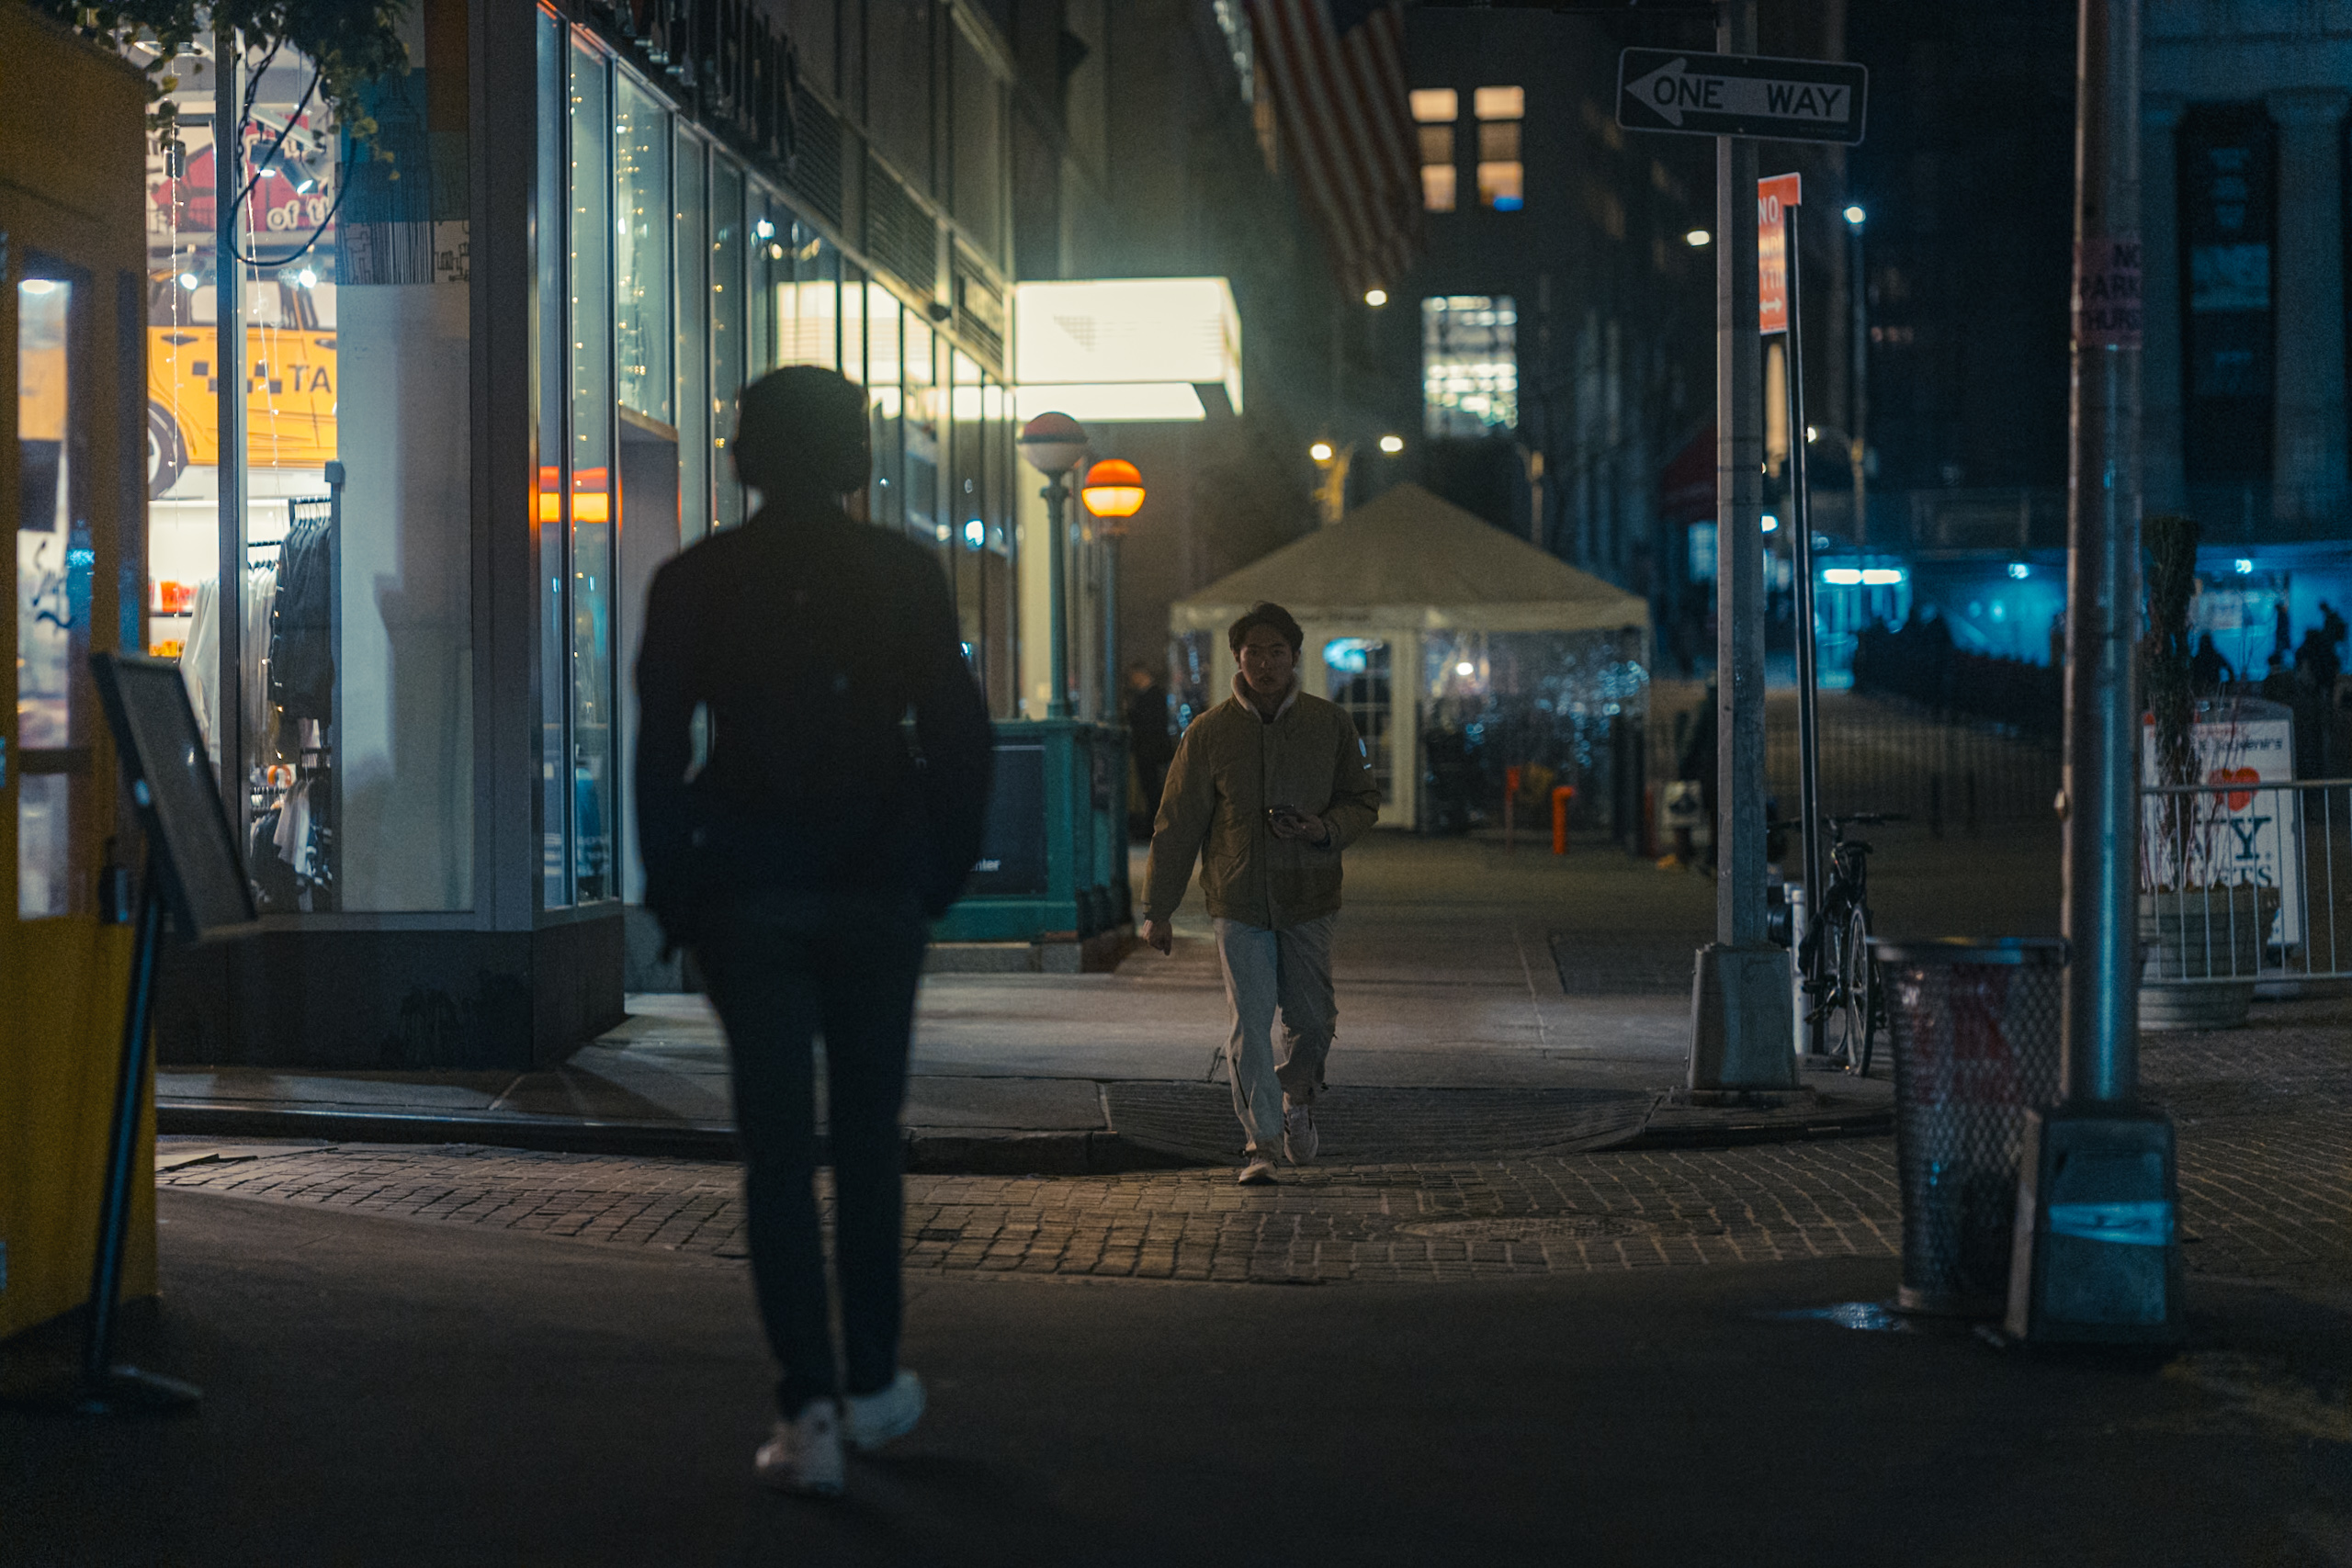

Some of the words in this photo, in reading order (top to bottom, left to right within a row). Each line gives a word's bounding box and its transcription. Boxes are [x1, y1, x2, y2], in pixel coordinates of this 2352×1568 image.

[1653, 75, 1724, 109] ONE
[1766, 83, 1842, 118] WAY
[266, 199, 300, 231] of
[1758, 194, 1780, 226] NO
[287, 363, 333, 395] TA
[969, 858, 1001, 872] nter
